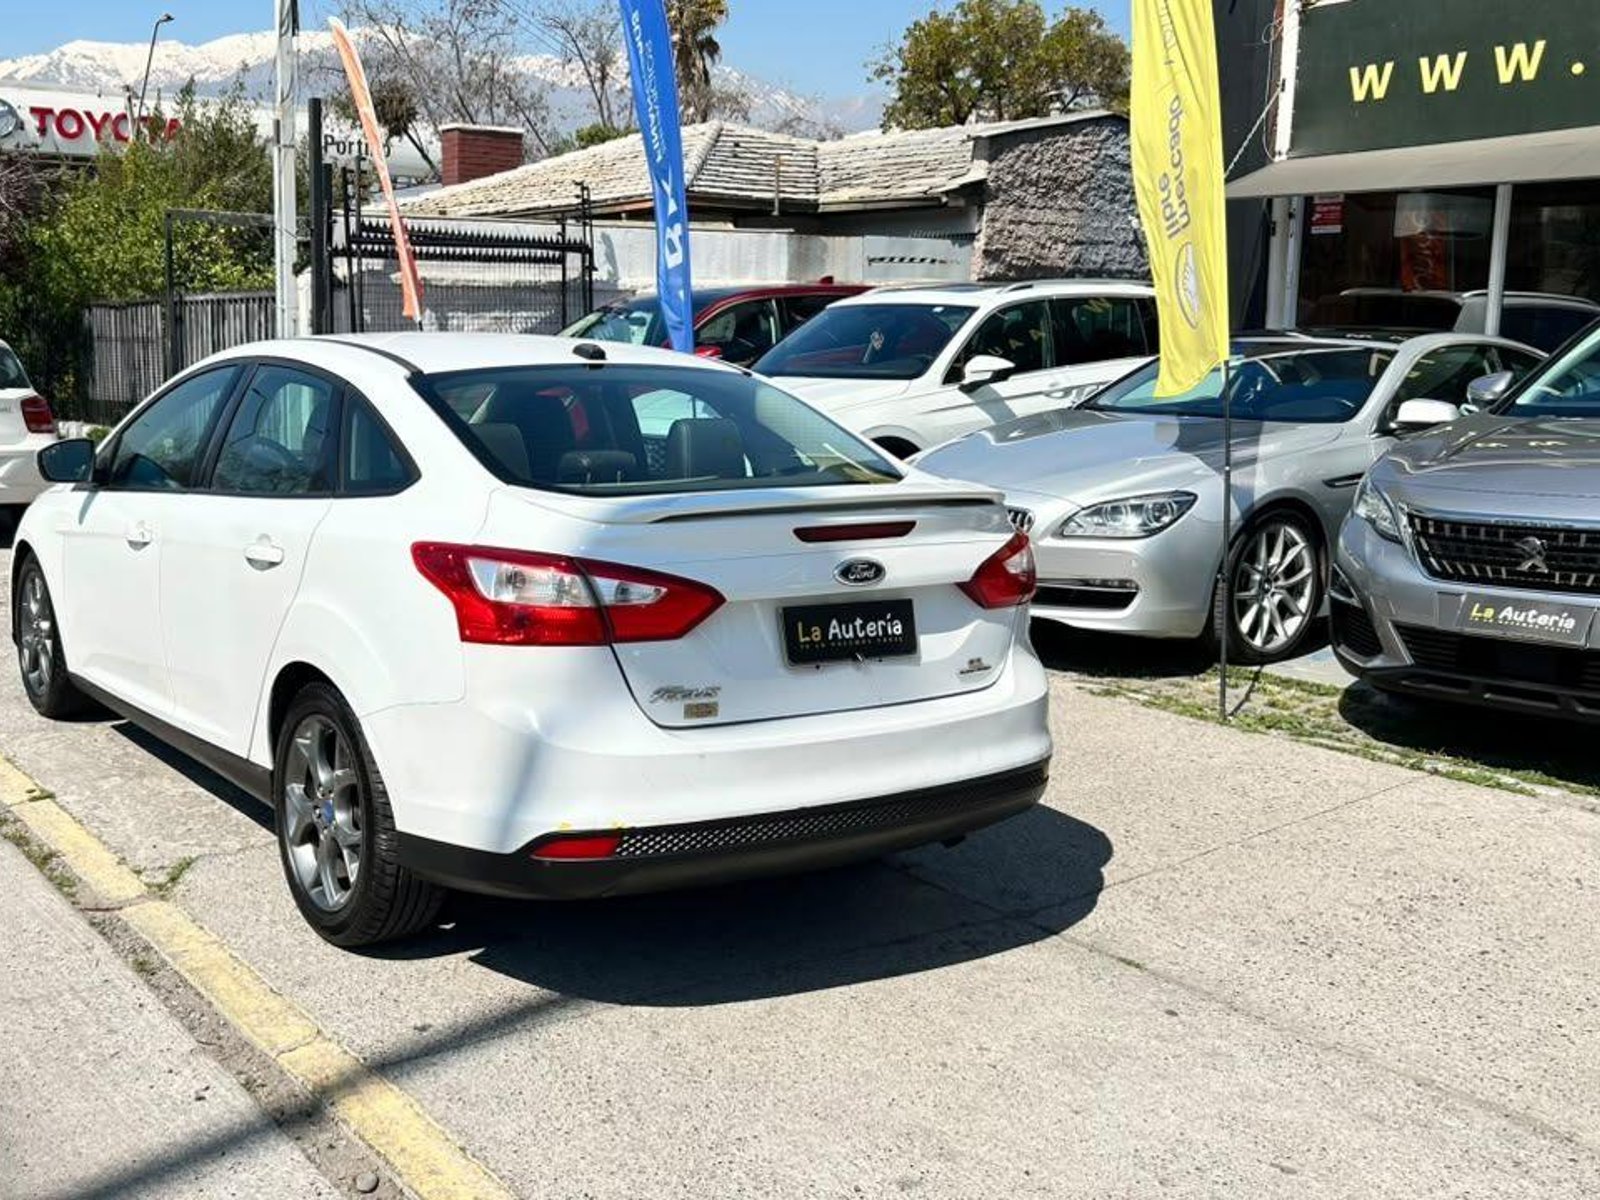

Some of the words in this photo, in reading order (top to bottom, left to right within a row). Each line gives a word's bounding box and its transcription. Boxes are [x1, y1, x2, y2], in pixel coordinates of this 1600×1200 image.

[848, 563, 877, 580] Ford
[797, 621, 822, 643] La
[828, 613, 903, 641] Autería
[1469, 602, 1495, 619] La
[1499, 606, 1577, 630] Autería
